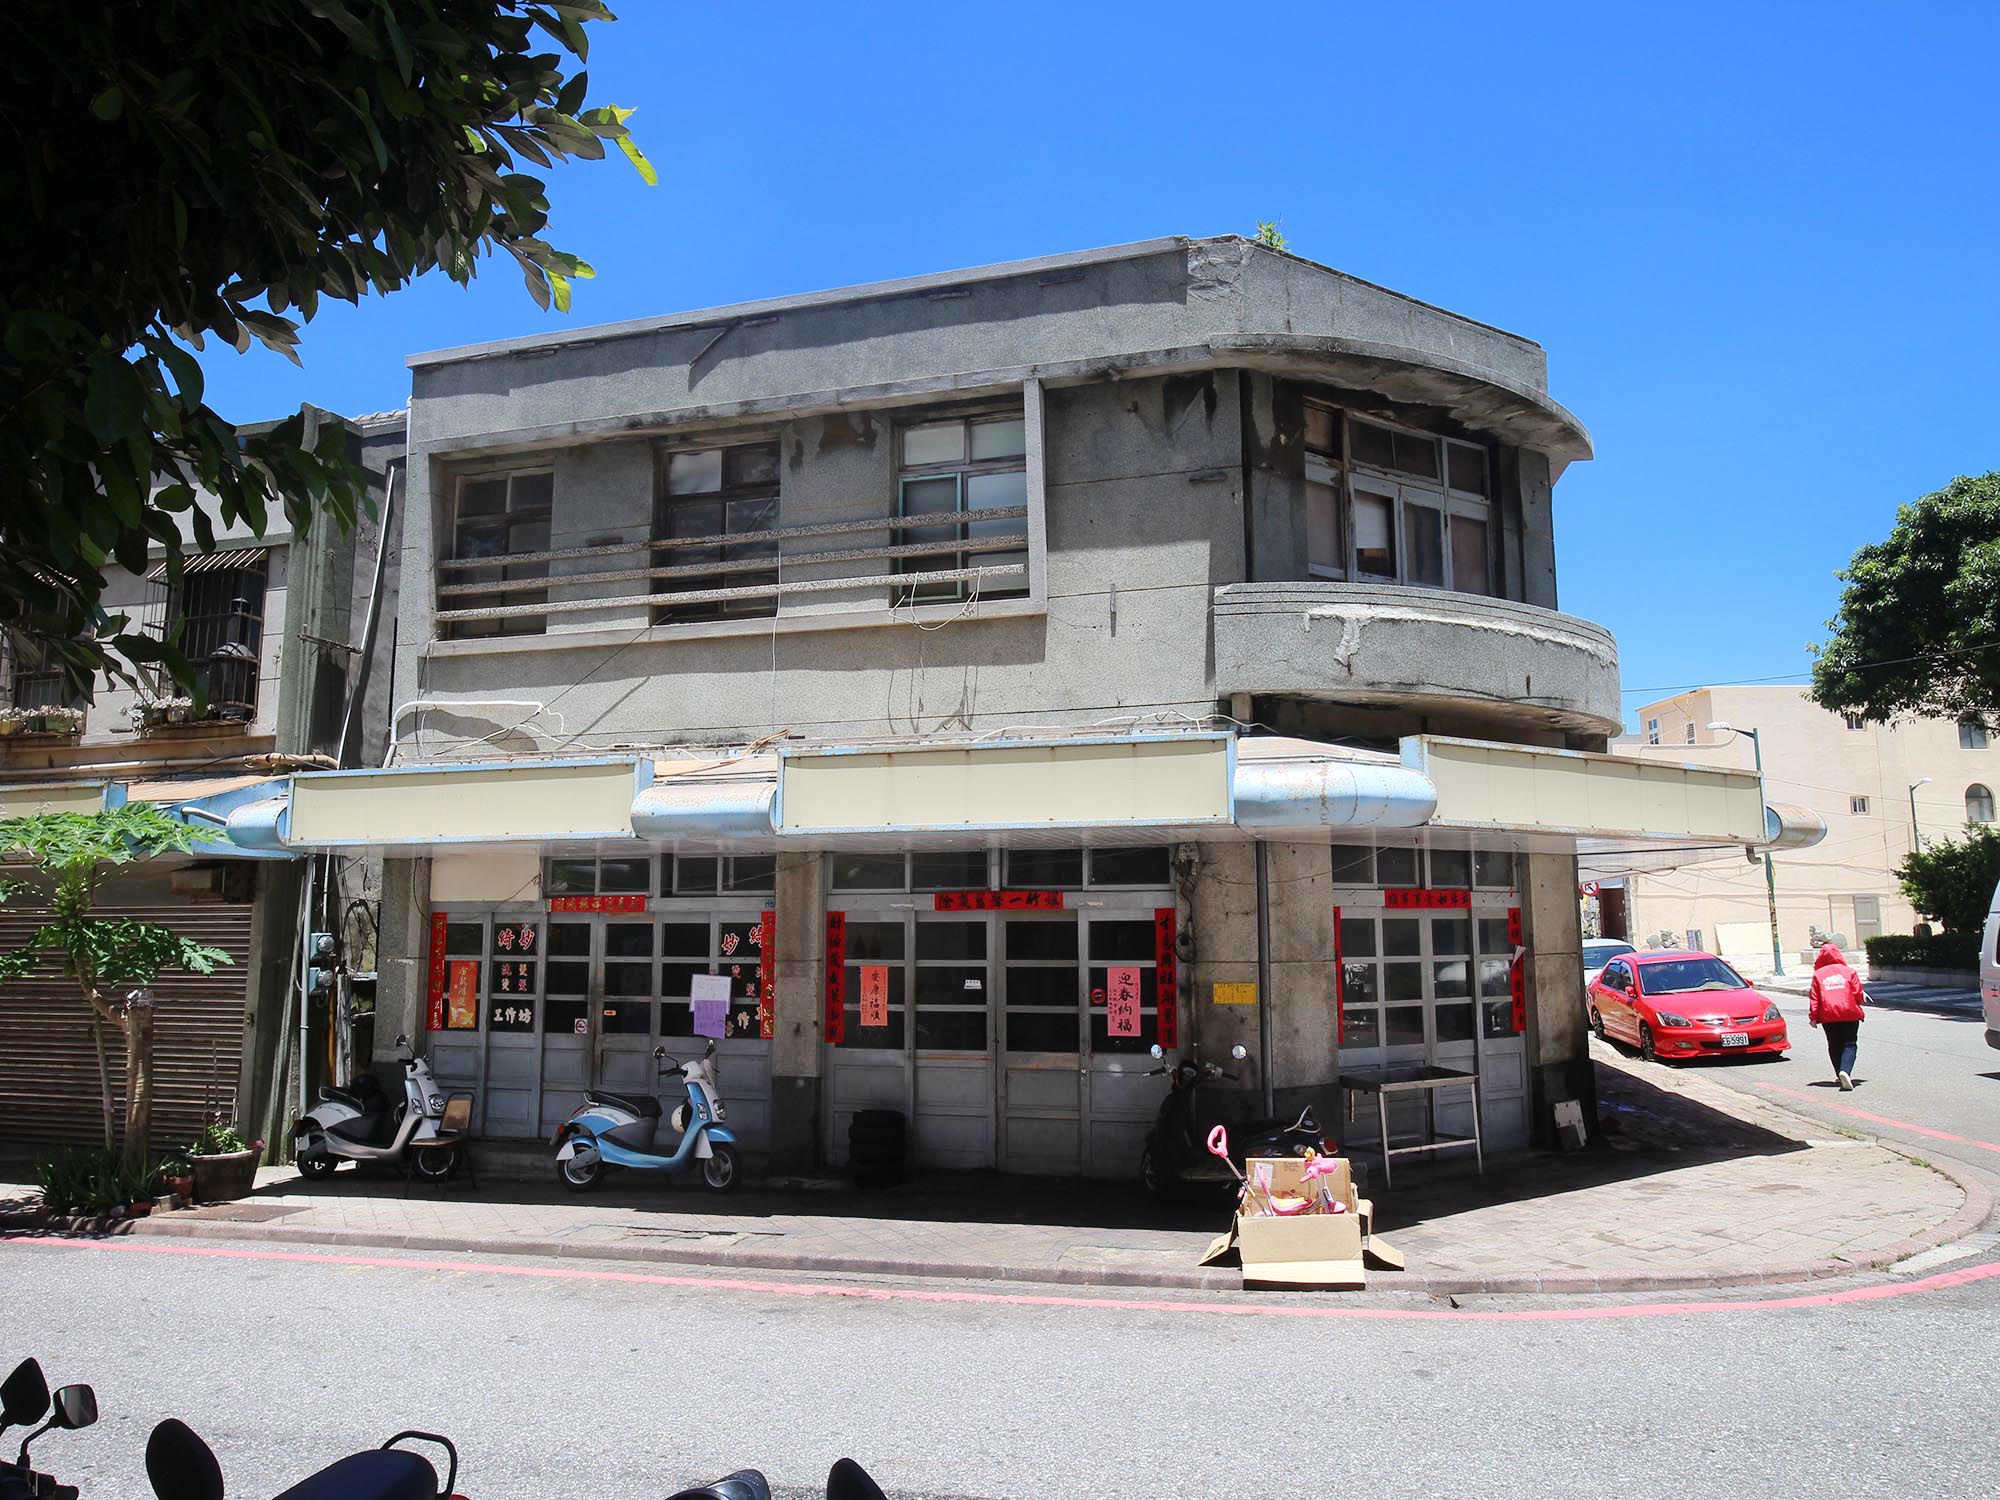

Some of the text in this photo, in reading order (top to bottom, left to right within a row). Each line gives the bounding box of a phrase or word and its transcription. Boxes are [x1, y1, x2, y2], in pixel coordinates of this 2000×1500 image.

[493, 1006, 533, 1024] 工作坊
[1116, 972, 1135, 1033] 迎春納福
